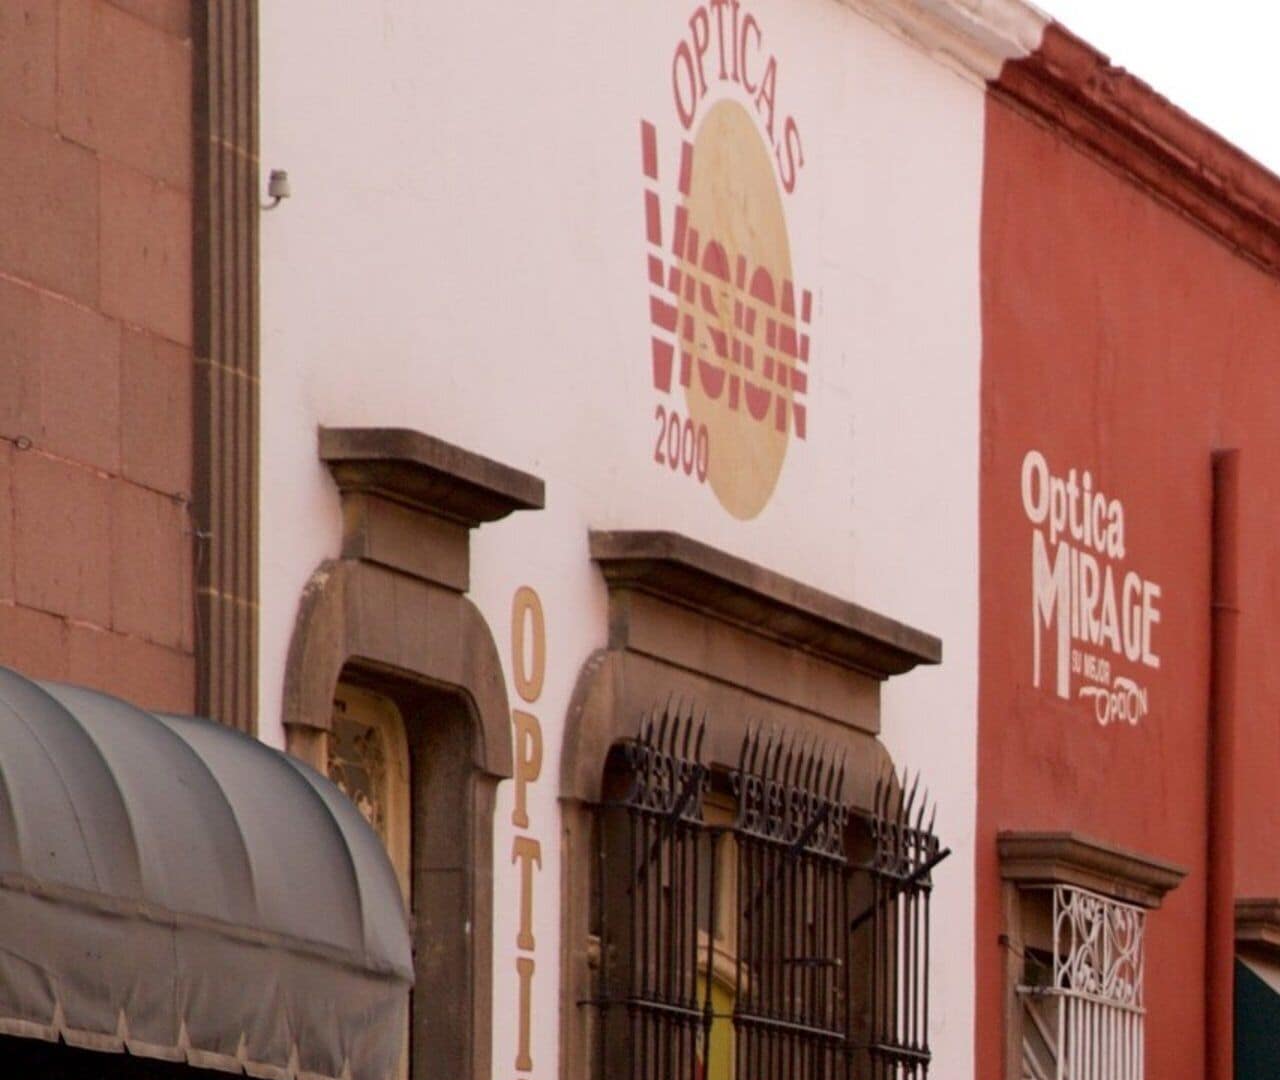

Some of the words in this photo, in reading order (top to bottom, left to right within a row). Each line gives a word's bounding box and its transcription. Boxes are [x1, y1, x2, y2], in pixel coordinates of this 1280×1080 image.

[671, 0, 805, 196] OPTICAS
[639, 118, 812, 441] VISION
[653, 404, 709, 485] 2000
[1021, 450, 1126, 561] Optica
[1032, 529, 1161, 700] MIRAGE
